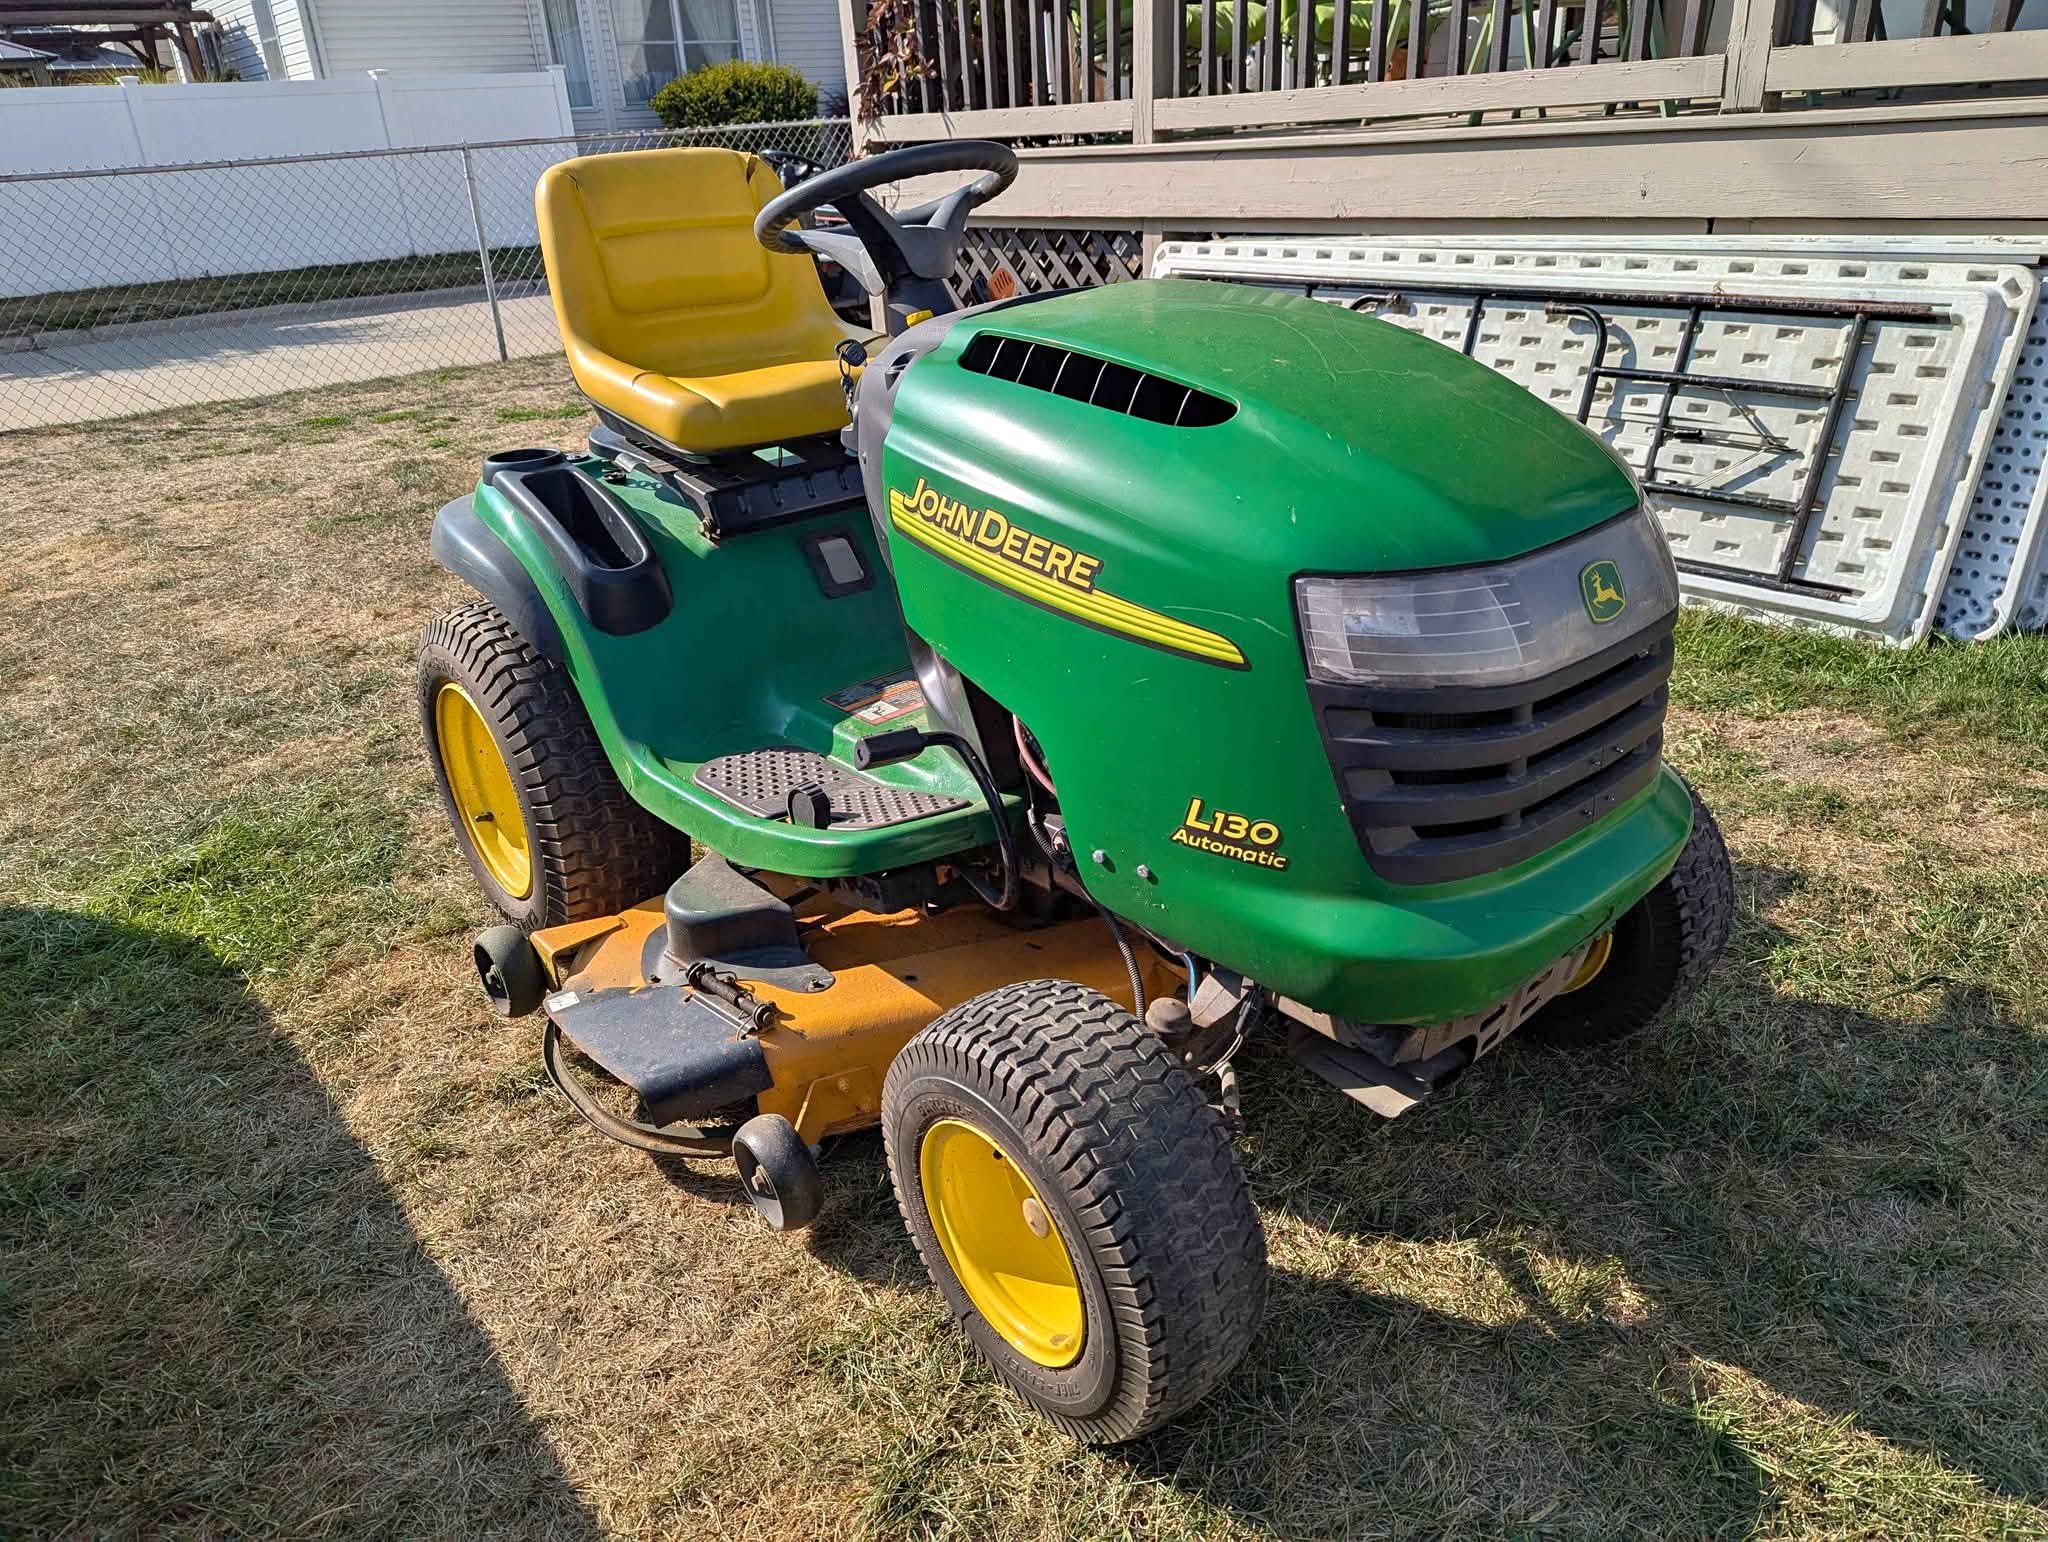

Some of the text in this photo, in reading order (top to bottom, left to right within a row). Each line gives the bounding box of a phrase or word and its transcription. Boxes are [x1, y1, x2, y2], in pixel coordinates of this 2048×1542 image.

[902, 477, 1101, 591] JOHN DEERE
[1184, 797, 1281, 846] L130
[1171, 827, 1288, 869] Automatic
